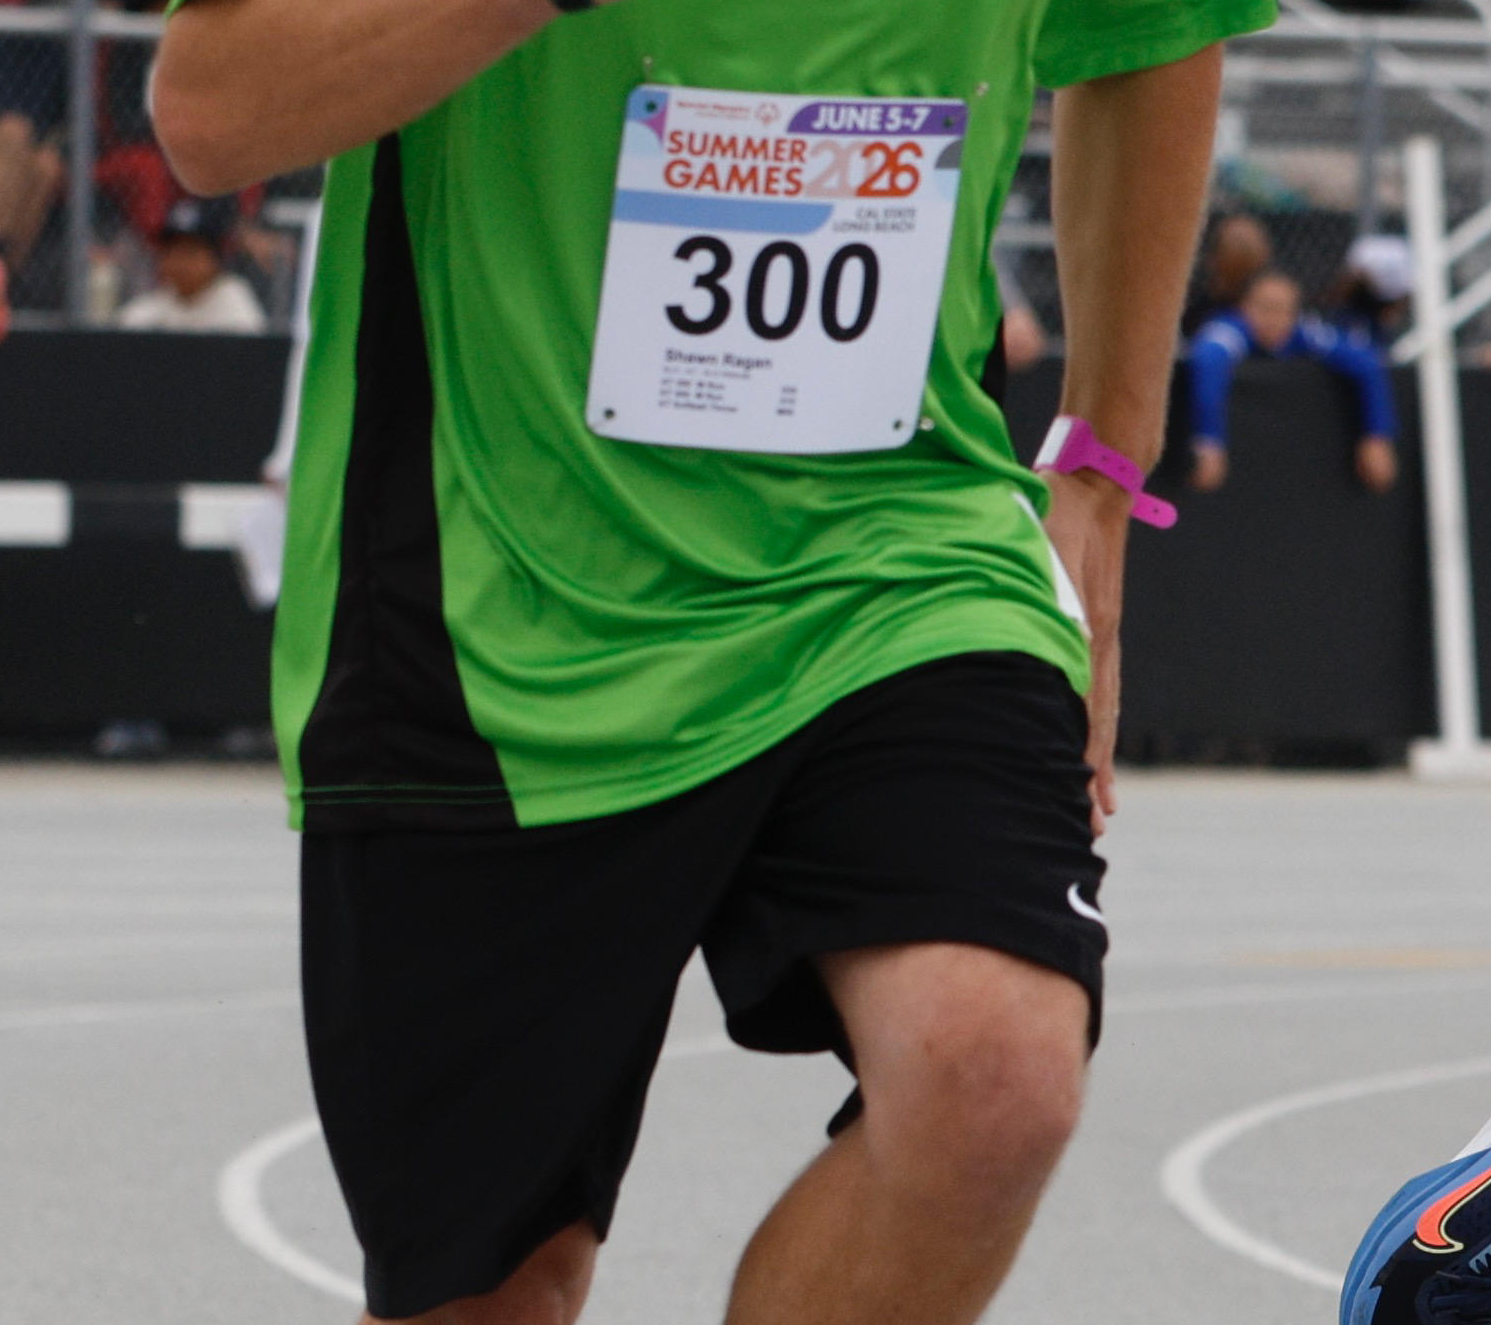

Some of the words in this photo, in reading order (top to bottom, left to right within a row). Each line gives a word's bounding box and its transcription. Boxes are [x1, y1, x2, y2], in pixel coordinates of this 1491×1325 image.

[811, 106, 883, 130] JUNE
[886, 107, 931, 131] 5-7
[664, 159, 802, 196] GAMES
[667, 130, 806, 163] SUMMER
[806, 140, 924, 198] 2026
[665, 236, 879, 343] 300
